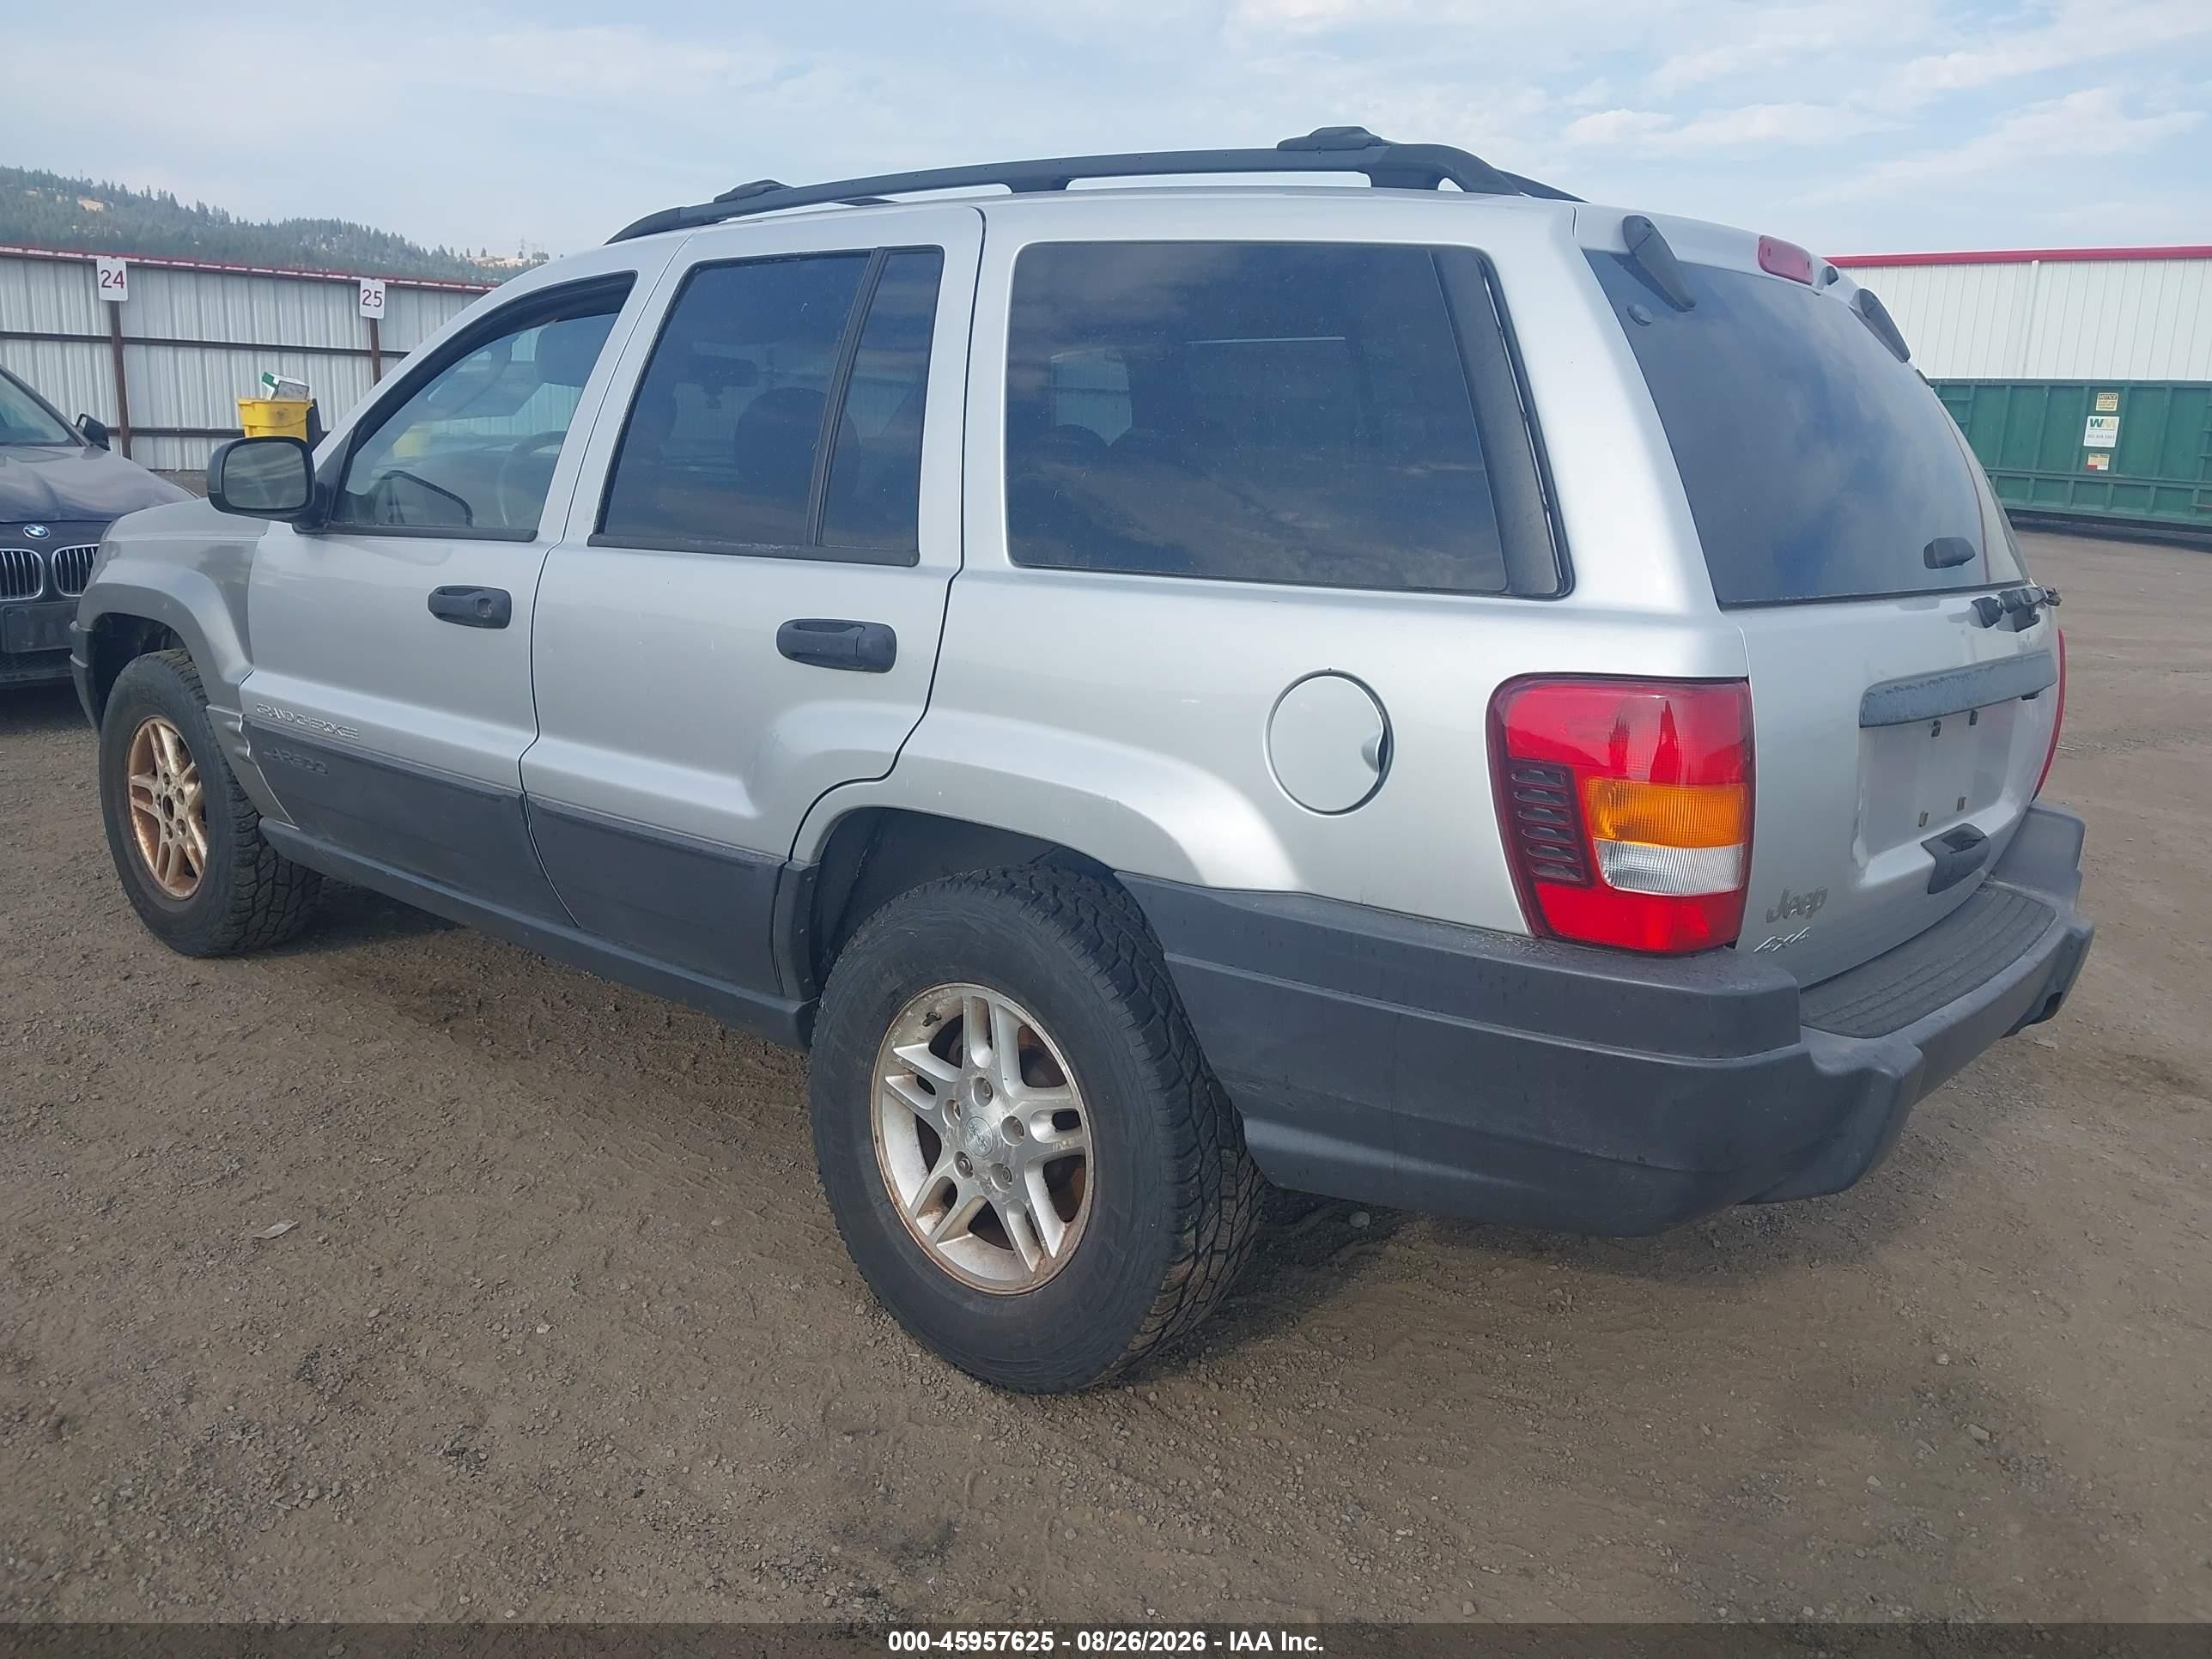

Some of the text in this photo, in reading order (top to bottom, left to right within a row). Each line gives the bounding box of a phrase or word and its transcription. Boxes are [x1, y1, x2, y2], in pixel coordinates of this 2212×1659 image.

[100, 269, 125, 289] 24
[362, 289, 383, 307] 25
[2089, 418, 2117, 428] WM
[257, 702, 359, 740] GRAND CHEROKEE
[1765, 886, 1828, 923] Jeep
